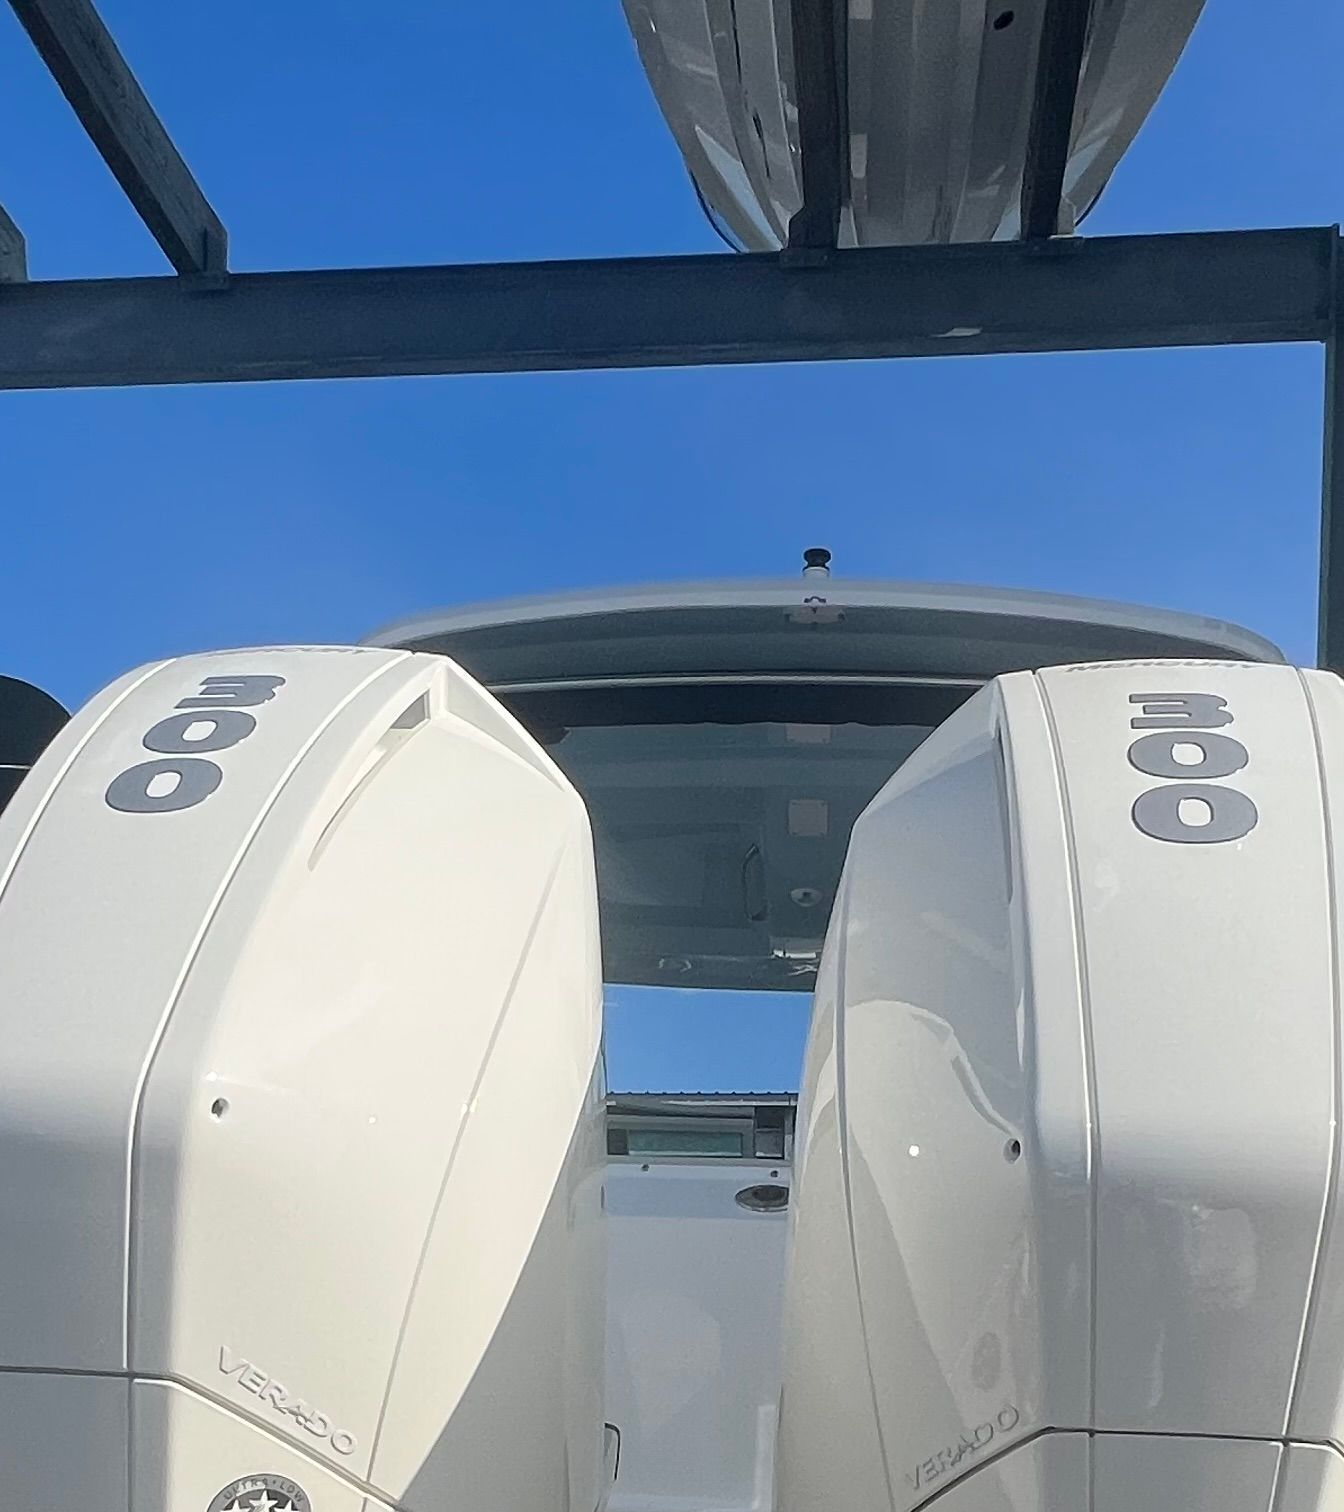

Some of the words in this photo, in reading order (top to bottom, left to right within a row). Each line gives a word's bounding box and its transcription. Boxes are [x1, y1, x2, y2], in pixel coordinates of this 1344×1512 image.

[105, 675, 286, 814] 300
[1127, 692, 1258, 844] 300
[218, 1345, 358, 1455] VERADO
[904, 1403, 1020, 1490] VERADO
